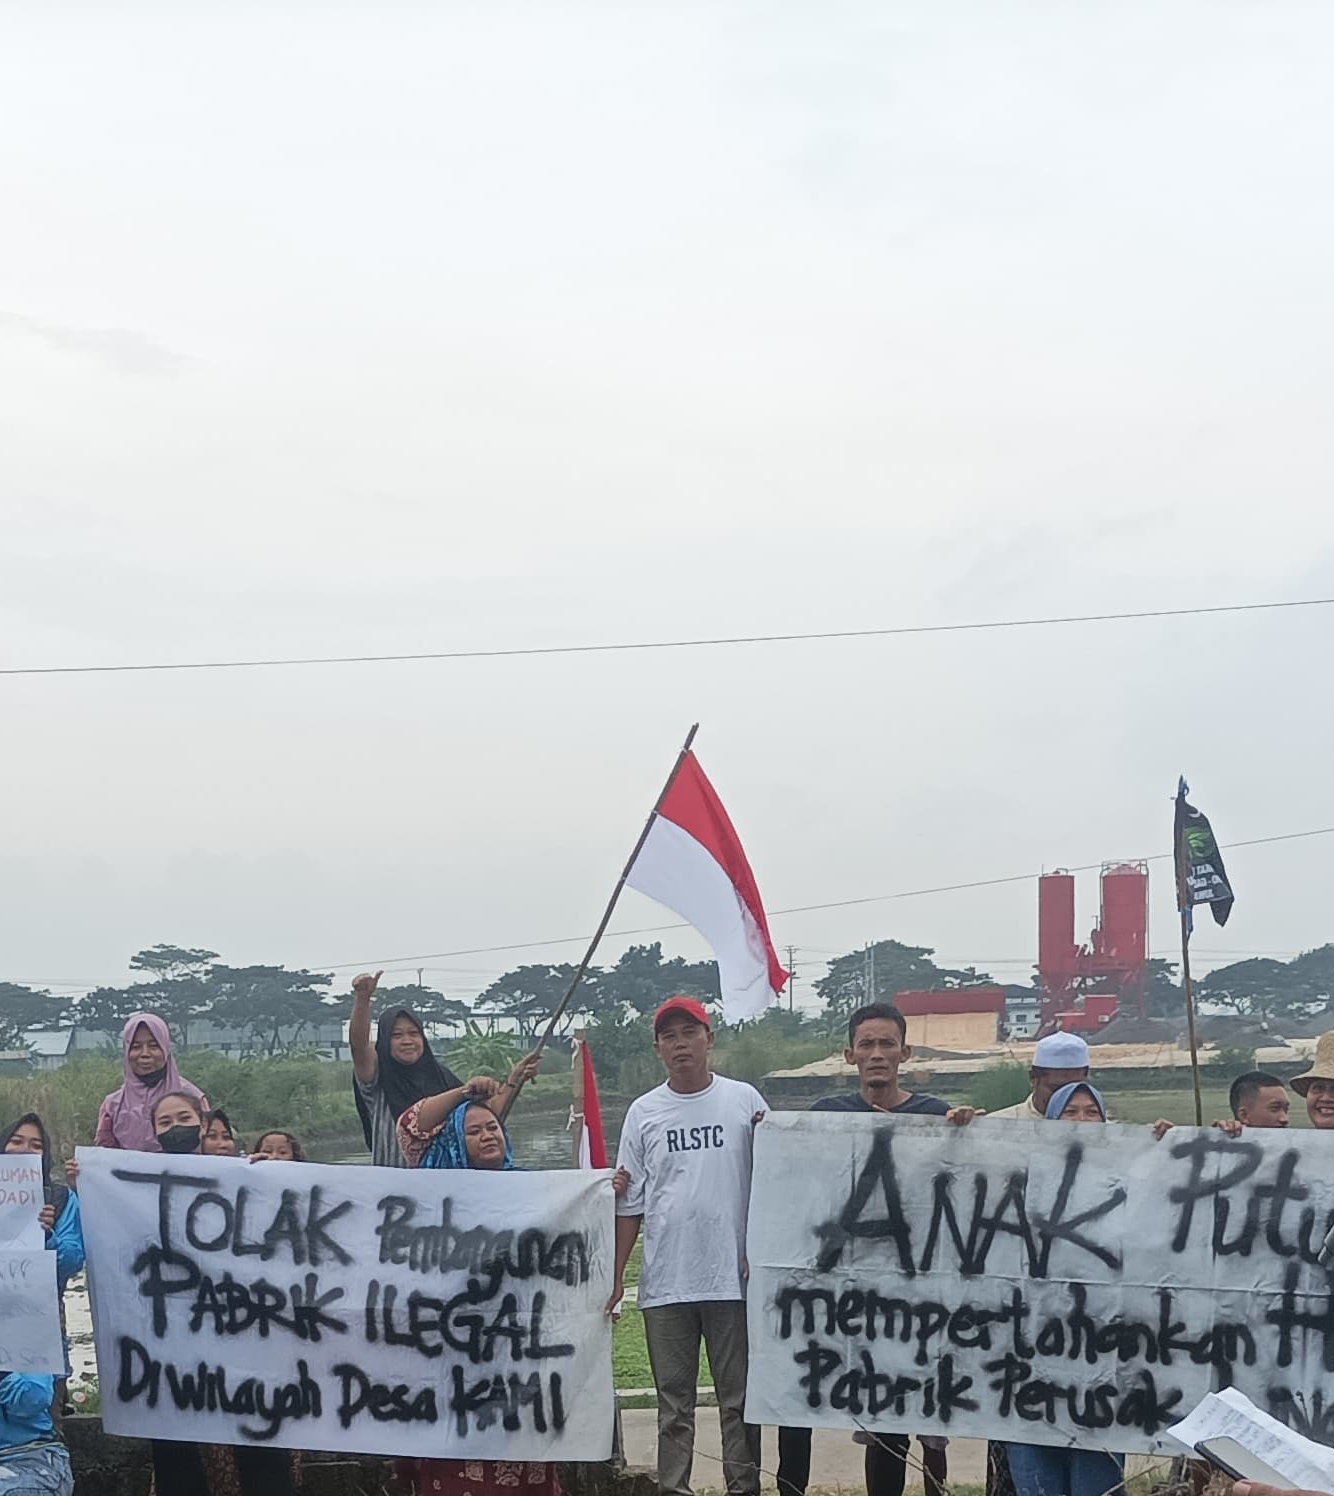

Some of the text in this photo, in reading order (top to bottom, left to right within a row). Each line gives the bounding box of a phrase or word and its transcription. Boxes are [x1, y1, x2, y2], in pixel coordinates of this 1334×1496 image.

[666, 1124, 724, 1153] RLSTC
[110, 1168, 354, 1267] TOLAK
[813, 1125, 1129, 1280] ANAK
[131, 1243, 576, 1365] PABRIK ILEGAL
[331, 1363, 439, 1430] Desa
